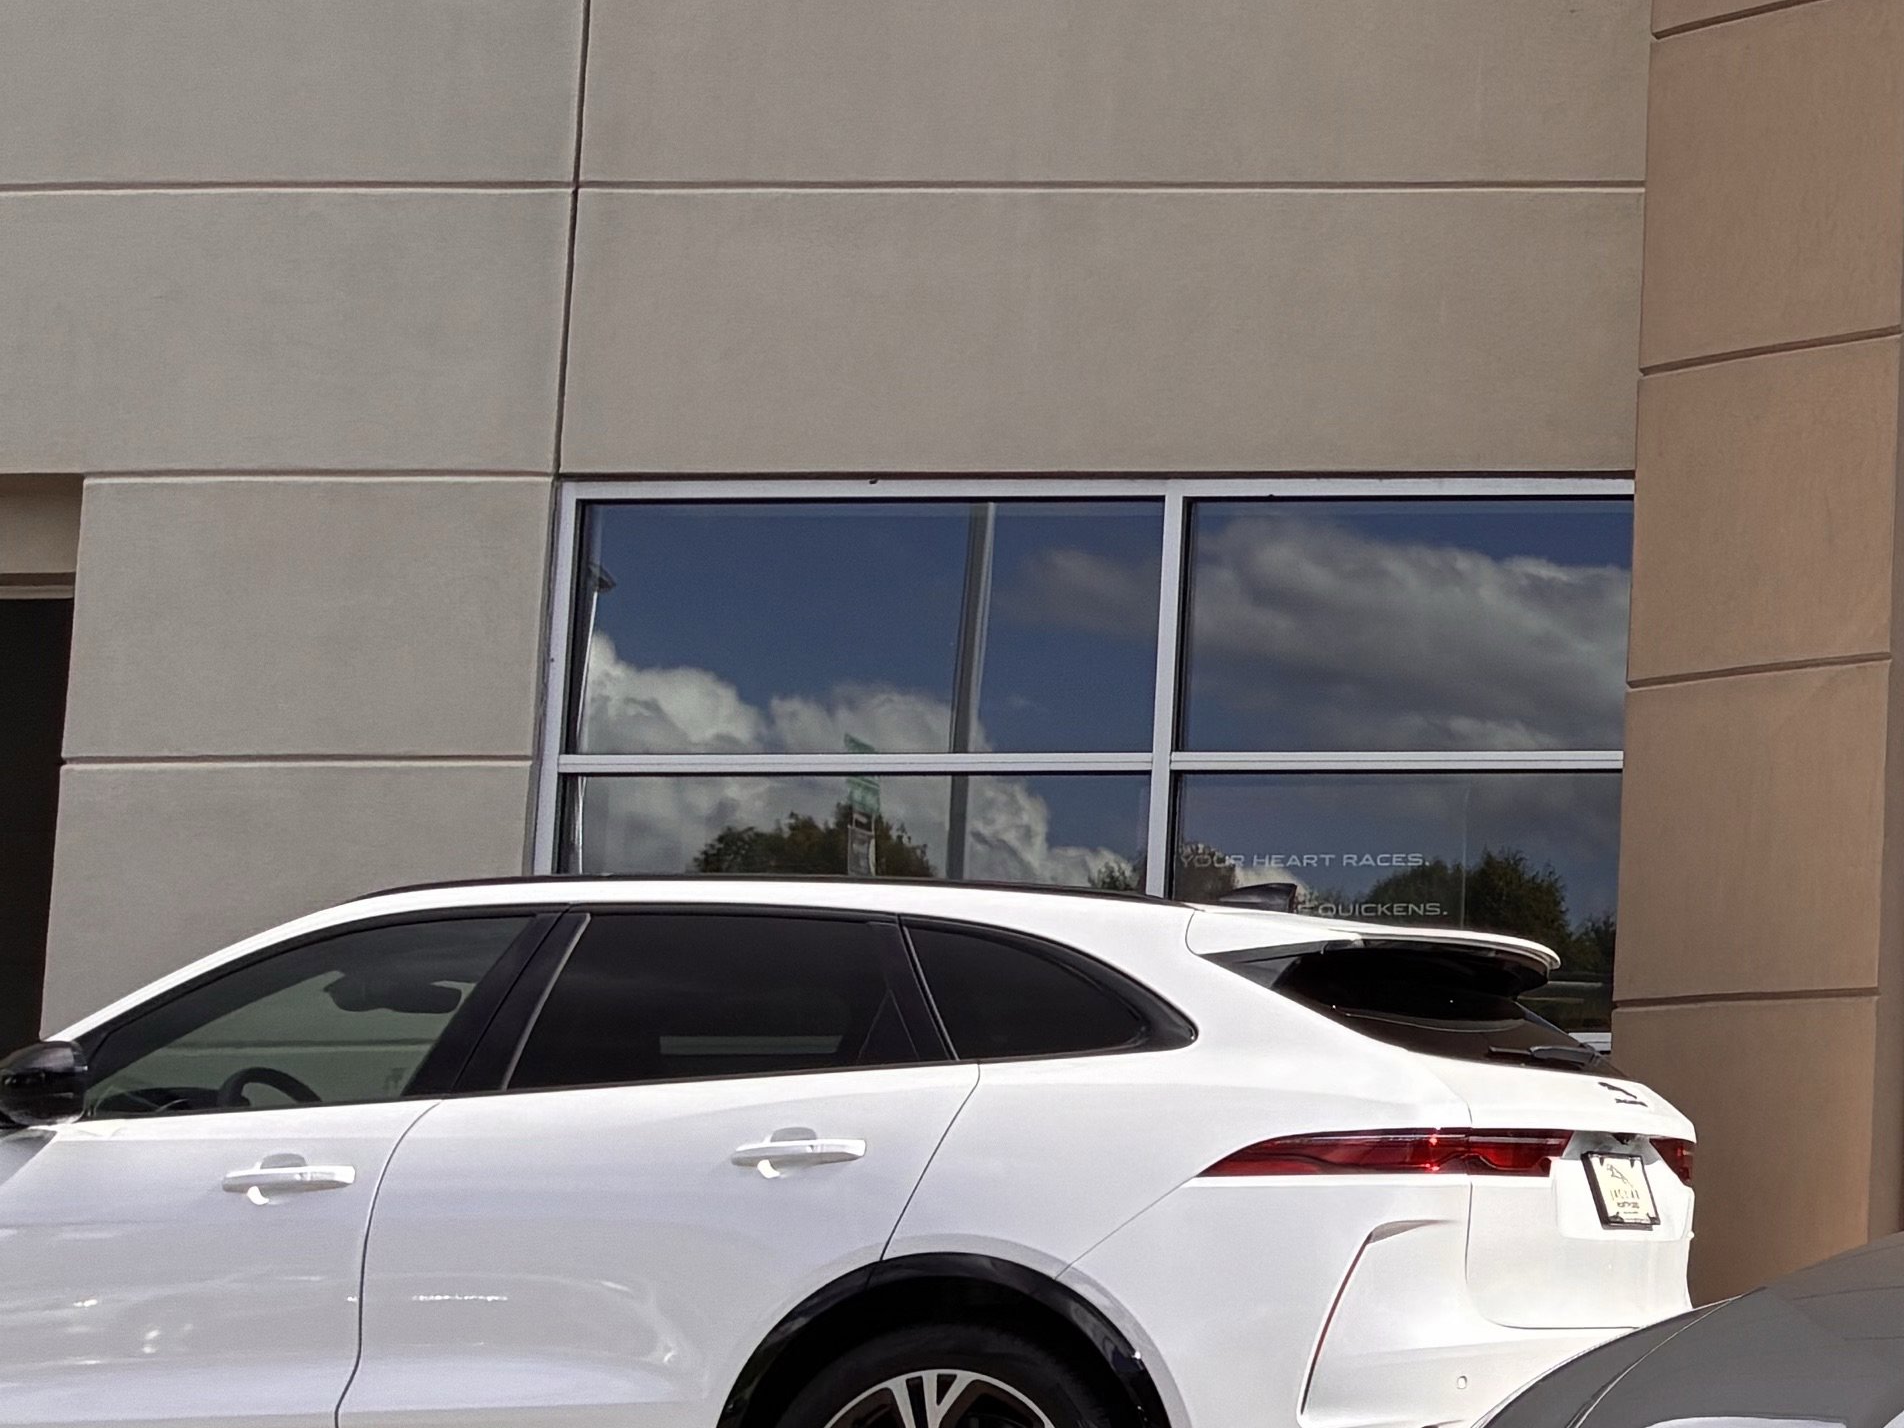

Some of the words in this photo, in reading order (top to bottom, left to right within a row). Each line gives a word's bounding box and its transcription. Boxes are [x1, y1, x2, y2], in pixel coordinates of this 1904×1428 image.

[1180, 854, 1245, 869] YOUR
[1253, 853, 1336, 868] HEART
[1343, 852, 1430, 867] RACES.
[1318, 902, 1448, 917] QUICKENS.
